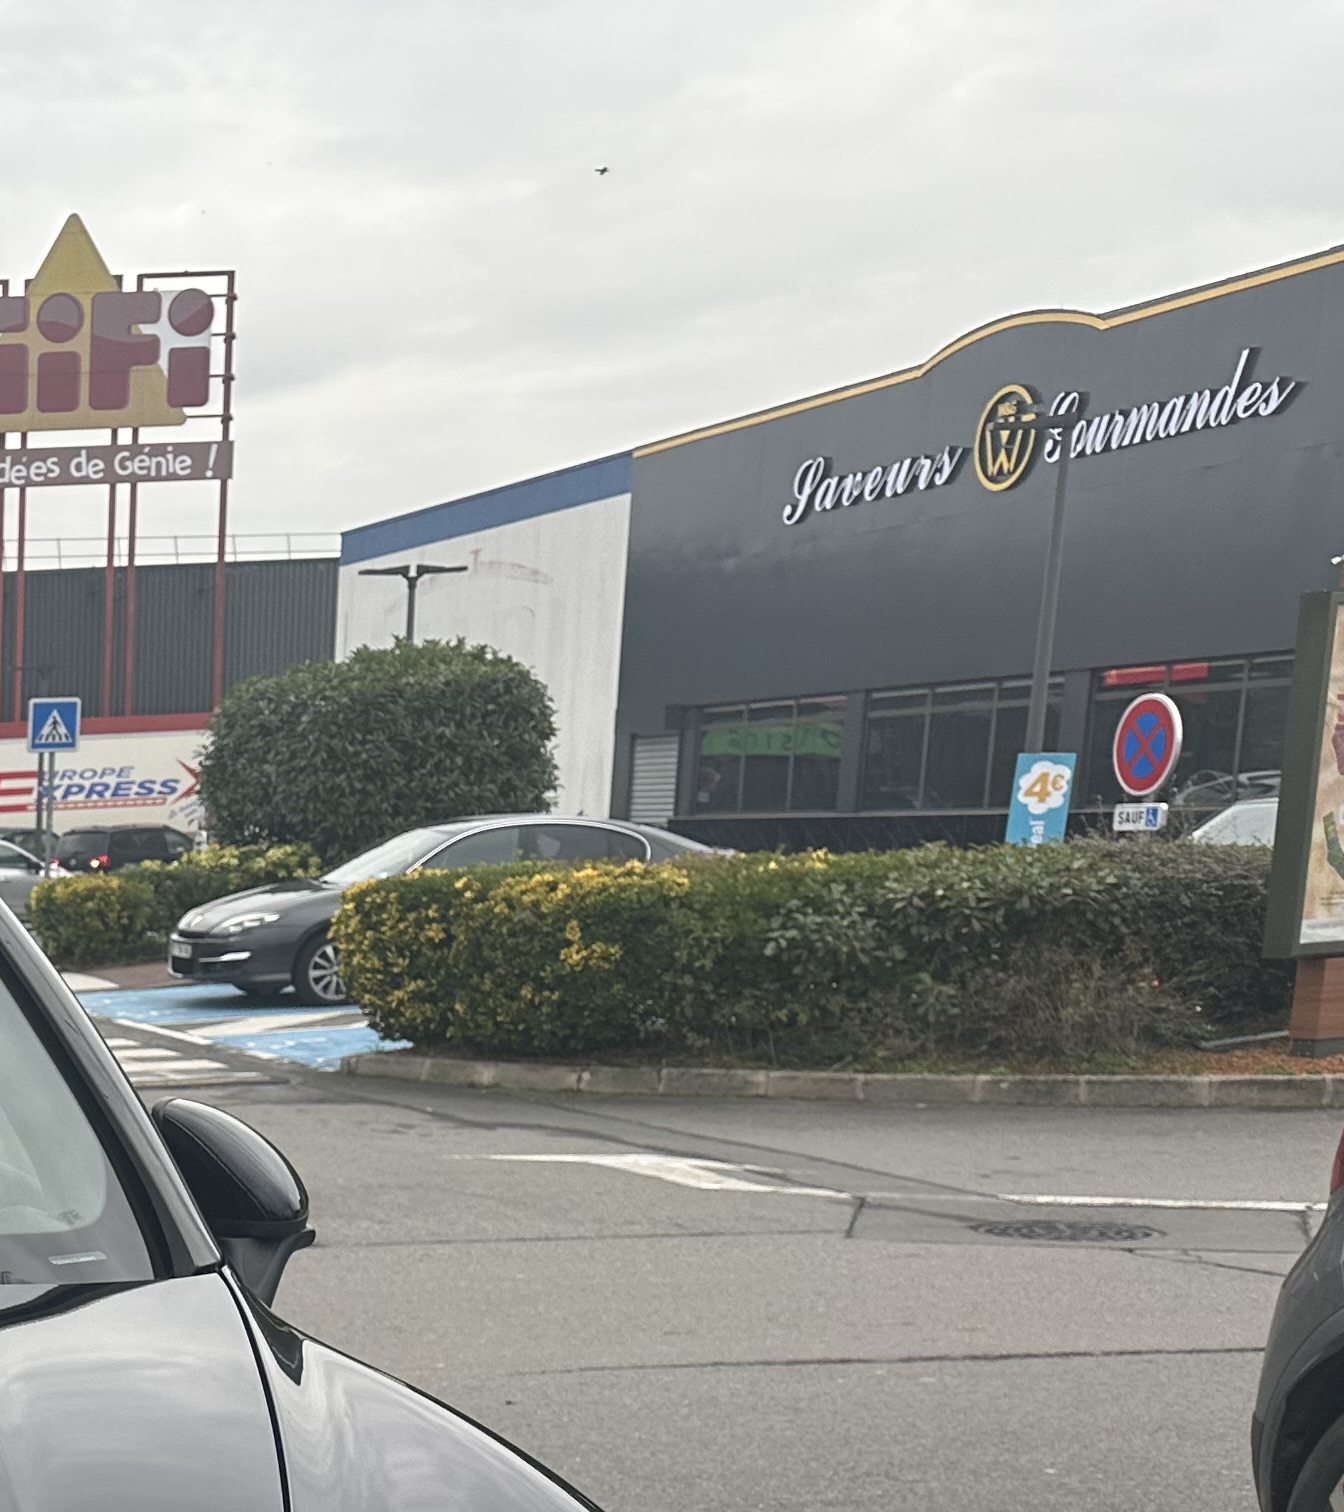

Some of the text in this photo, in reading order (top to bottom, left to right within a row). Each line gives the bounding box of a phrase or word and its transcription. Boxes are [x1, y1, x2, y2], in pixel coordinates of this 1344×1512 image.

[69, 449, 105, 479] de
[114, 446, 192, 478] Génie
[205, 443, 218, 479] !
[782, 447, 964, 526] Saveurs
[1022, 771, 1066, 804] 4€
[1118, 811, 1146, 826] SAUF
